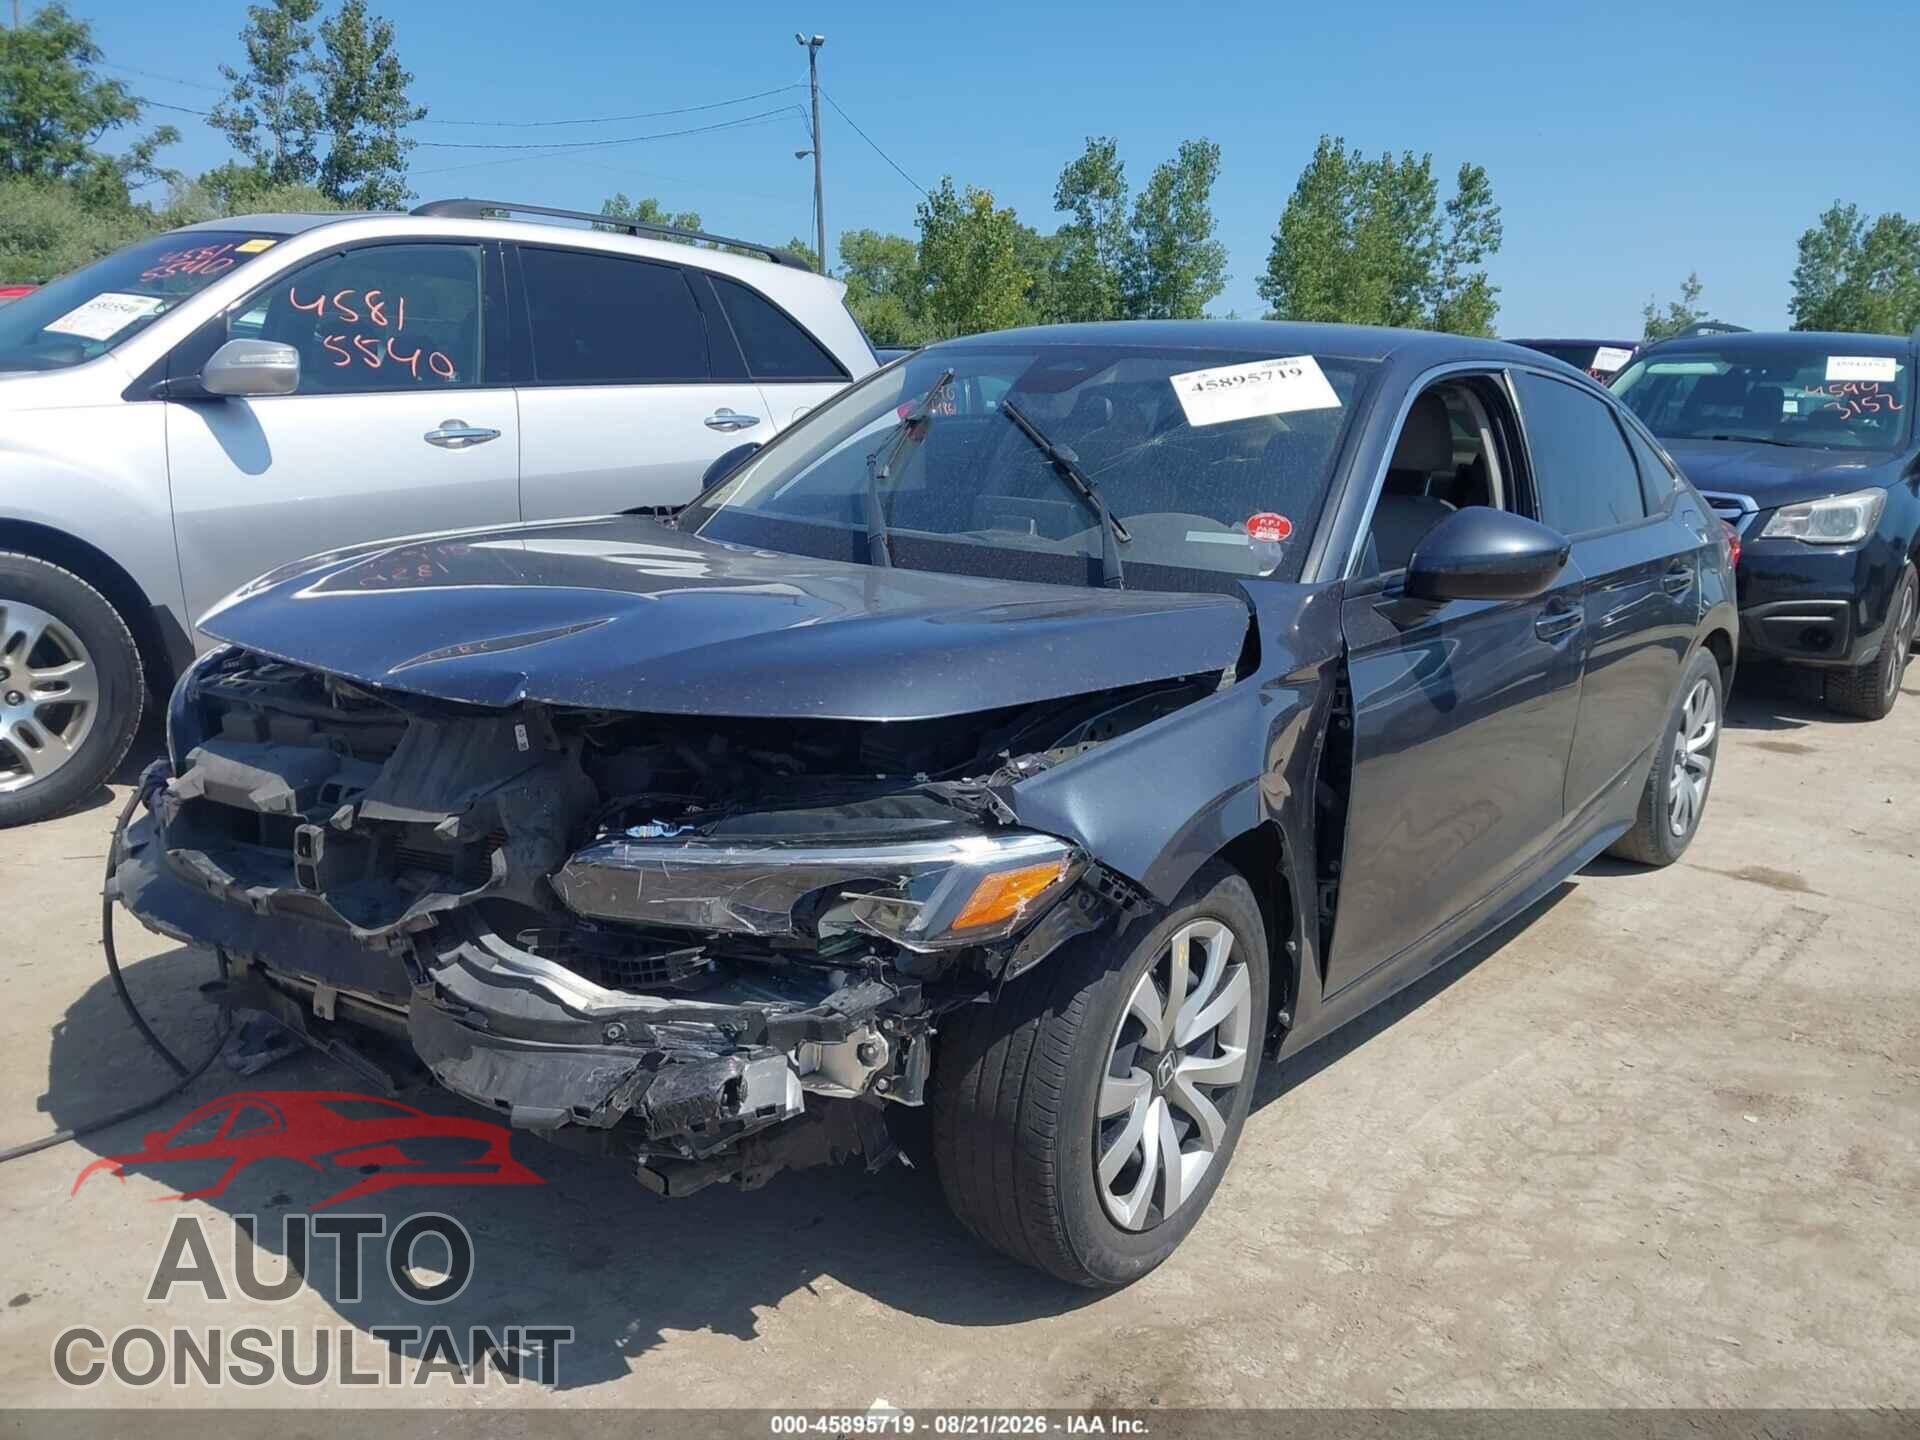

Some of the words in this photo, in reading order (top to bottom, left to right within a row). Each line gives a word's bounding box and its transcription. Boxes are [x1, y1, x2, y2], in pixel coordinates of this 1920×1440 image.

[289, 287, 405, 331] 4581
[323, 334, 454, 378] 5540
[1191, 366, 1303, 393] 45895719
[1823, 393, 1905, 420] 3152
